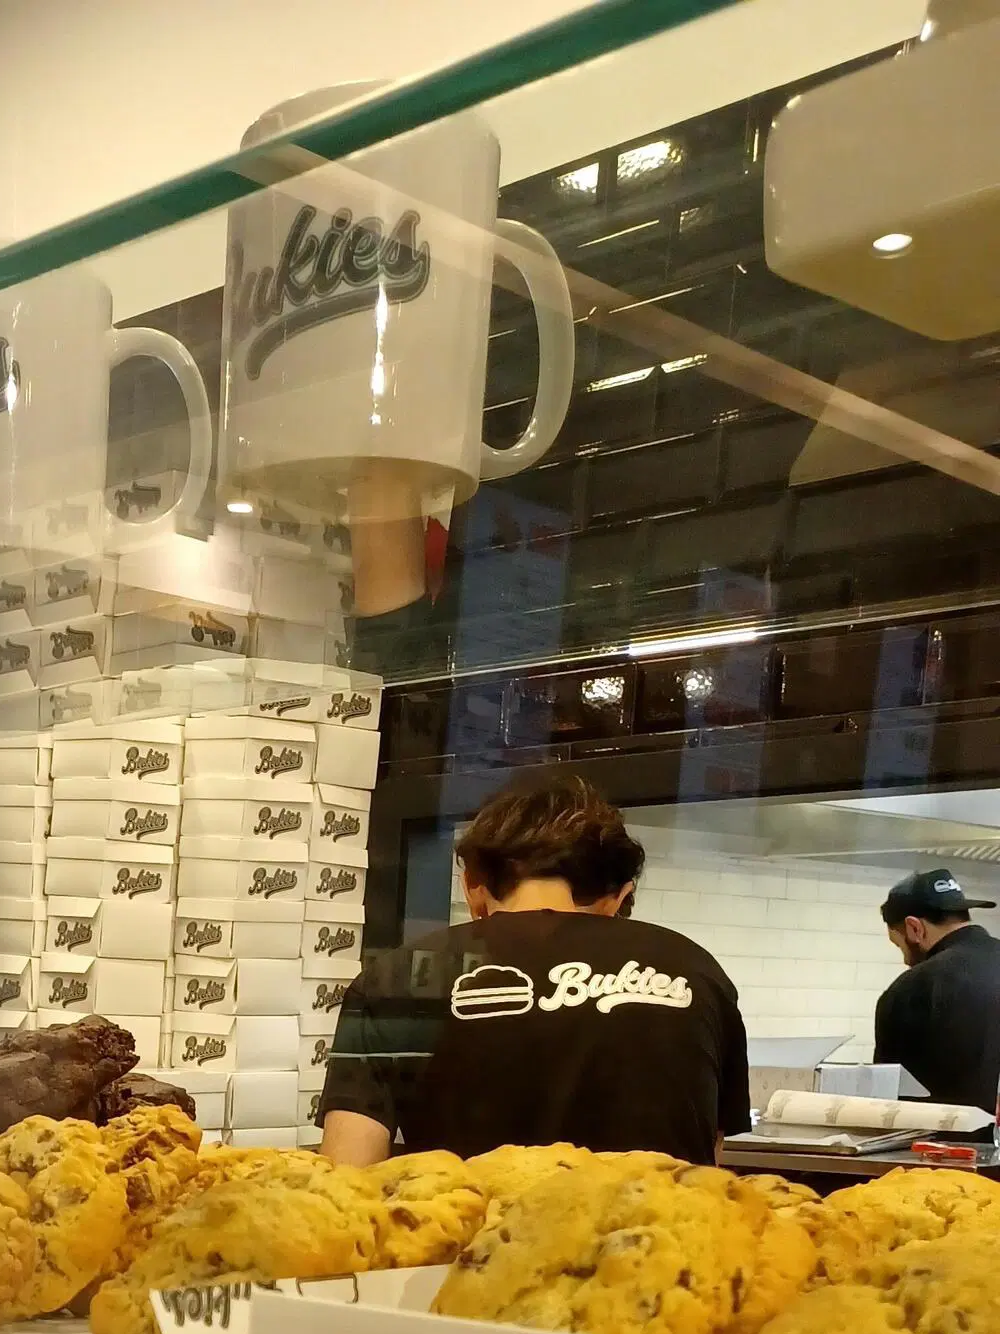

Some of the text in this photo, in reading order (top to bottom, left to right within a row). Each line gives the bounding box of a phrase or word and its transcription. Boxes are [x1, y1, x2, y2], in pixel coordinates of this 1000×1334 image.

[122, 746, 169, 779] Bukies
[255, 745, 303, 779] Bukies
[120, 808, 168, 840] Bukies
[254, 807, 301, 840] Bukies
[320, 811, 360, 842] Bukies
[112, 867, 162, 899] Bukies
[249, 867, 298, 899] Bukies
[317, 867, 356, 899] Bukies
[314, 926, 354, 957] Bukies
[184, 978, 226, 1010] Bukies
[538, 960, 693, 1013] Bukies
[182, 1035, 226, 1066] Bukies
